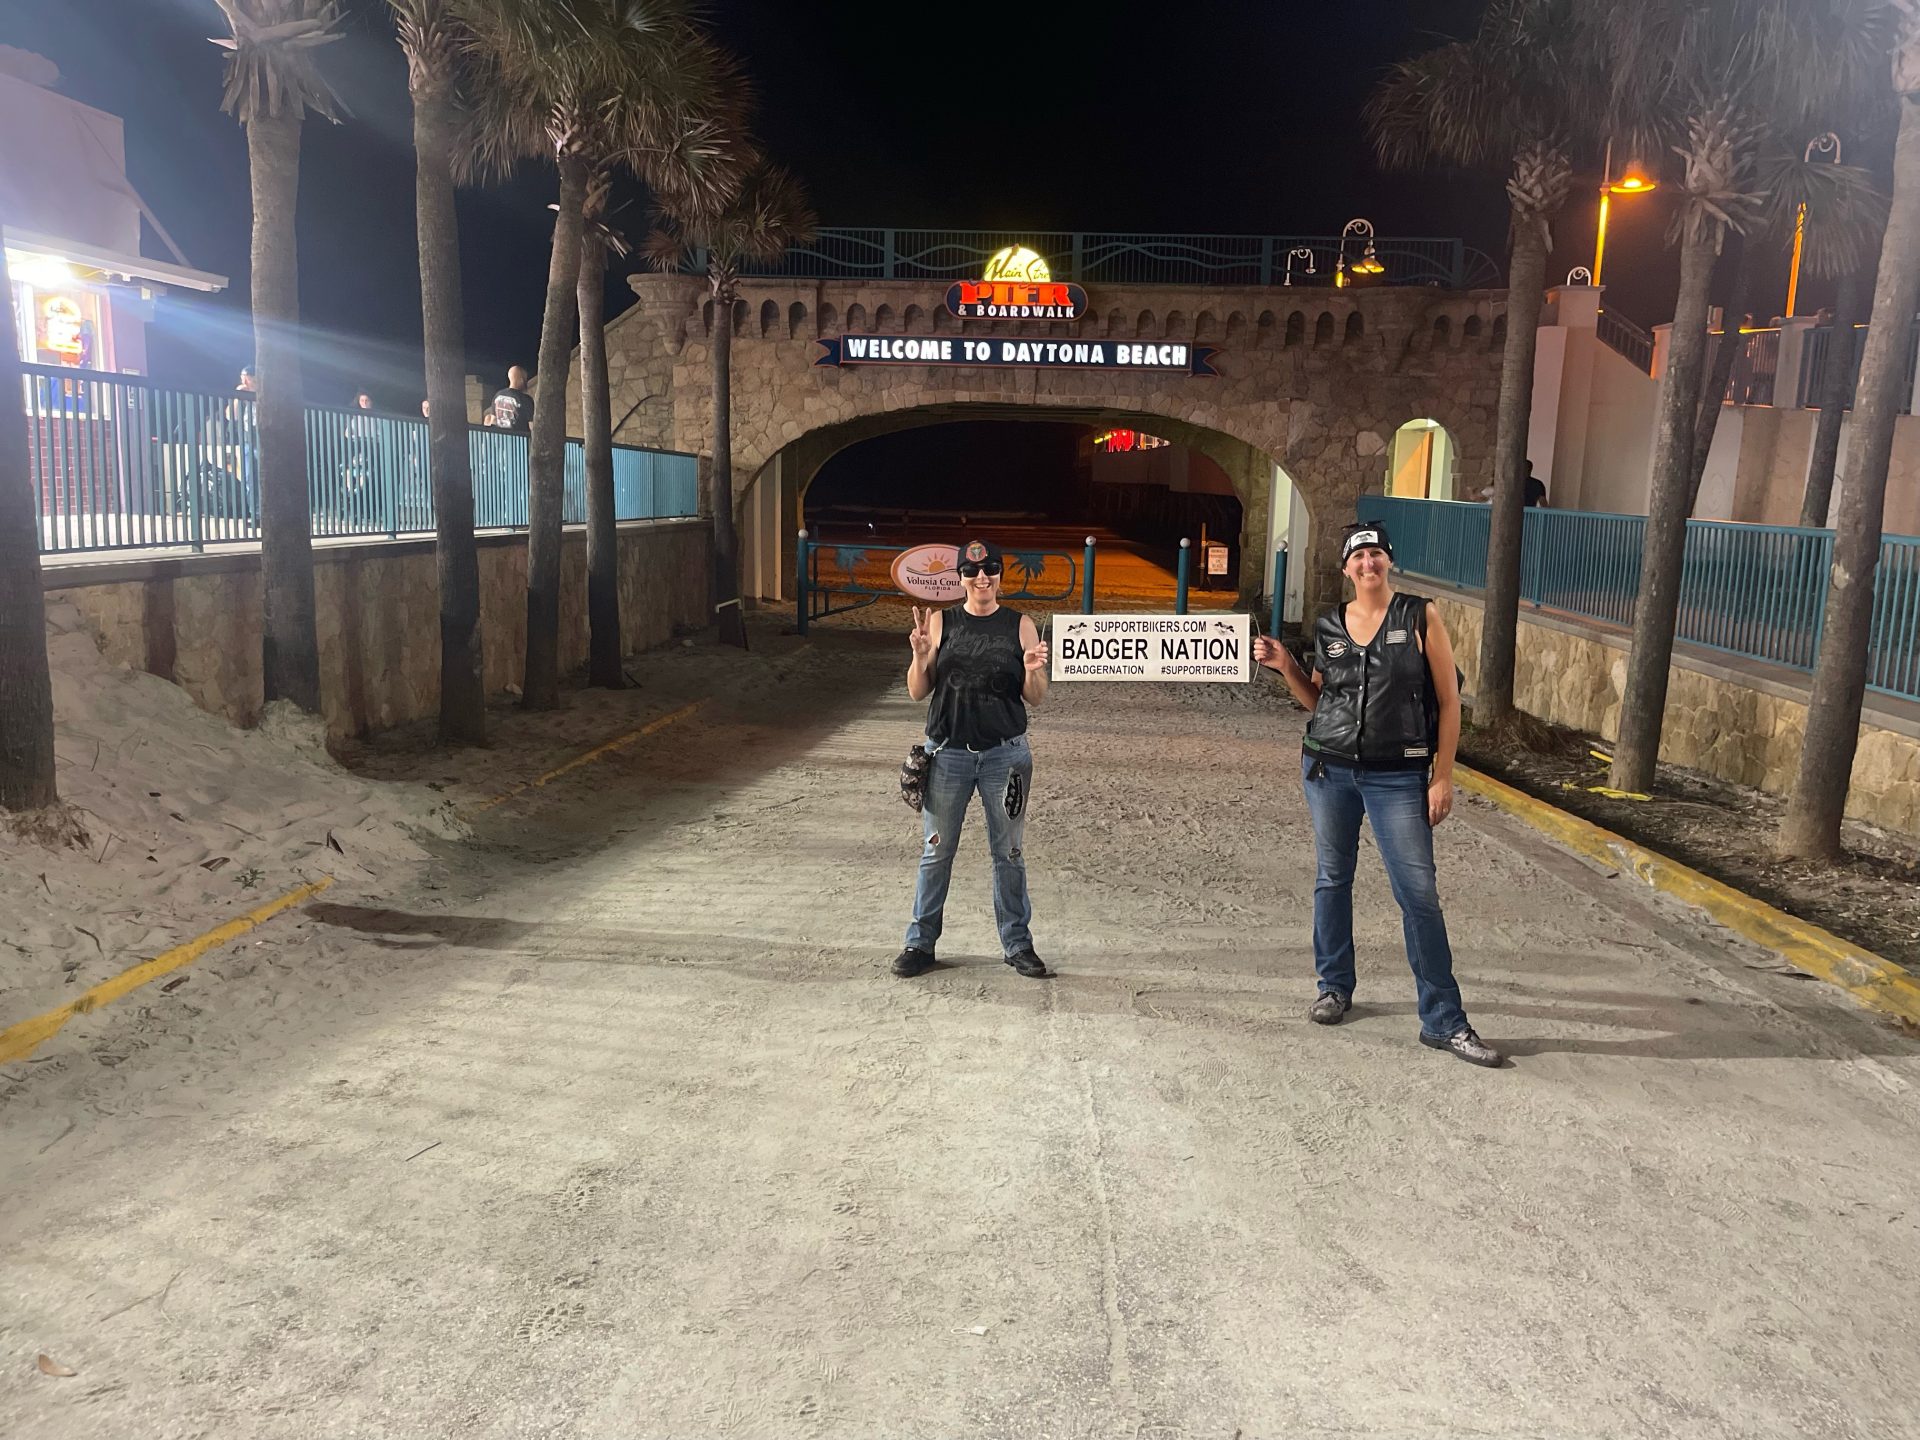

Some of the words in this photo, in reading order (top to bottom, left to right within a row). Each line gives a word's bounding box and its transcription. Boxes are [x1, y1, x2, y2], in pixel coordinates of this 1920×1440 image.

[985, 243, 1022, 281] Main
[960, 281, 1074, 306] PIER
[957, 304, 968, 317] &
[976, 304, 1075, 319] BOARDWALK
[847, 338, 952, 361] WELCOME
[963, 341, 991, 361] TO
[1002, 342, 1105, 365] DAYTONA
[1116, 344, 1187, 366] BEACH
[906, 576, 938, 586] Volusia
[1094, 620, 1207, 633] SUPPORTBIKERS.COM
[1062, 638, 1149, 660] BADGER
[1160, 638, 1239, 660] NATION
[1064, 664, 1145, 675] #BADGERNATION
[1160, 665, 1239, 675] #SUPPORTBIKERS
